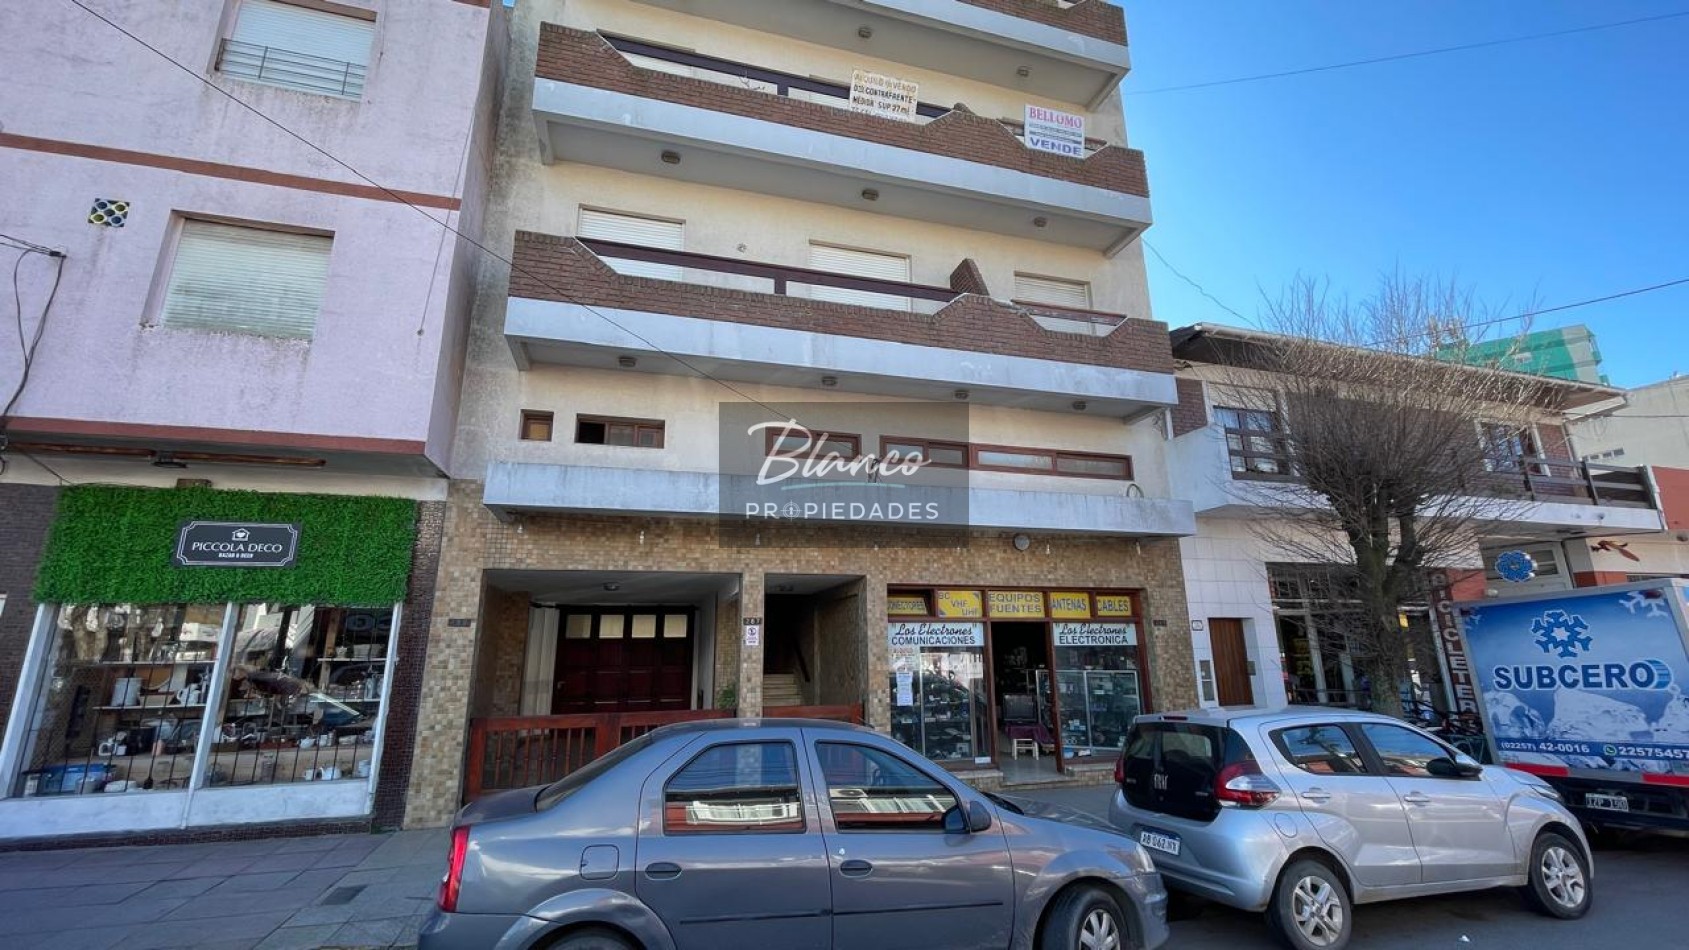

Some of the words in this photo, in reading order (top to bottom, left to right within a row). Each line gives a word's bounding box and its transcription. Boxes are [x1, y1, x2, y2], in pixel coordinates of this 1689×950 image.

[1029, 107, 1083, 129] BELLOMO
[1029, 136, 1082, 157] VENDE
[191, 541, 245, 552] PICCOLA
[247, 543, 283, 554] DECO
[951, 599, 968, 608] VHF
[988, 593, 1041, 603] EQUIPOS
[989, 603, 1042, 613] FUENTES
[1051, 598, 1087, 612] ANTENAS
[1097, 600, 1129, 612] CABLES
[891, 635, 976, 646] COMUNICACIONES
[1058, 635, 1129, 645] ELECTRONICA
[1494, 661, 1657, 690] SUBCERO
[1538, 742, 1590, 753] 42-0016
